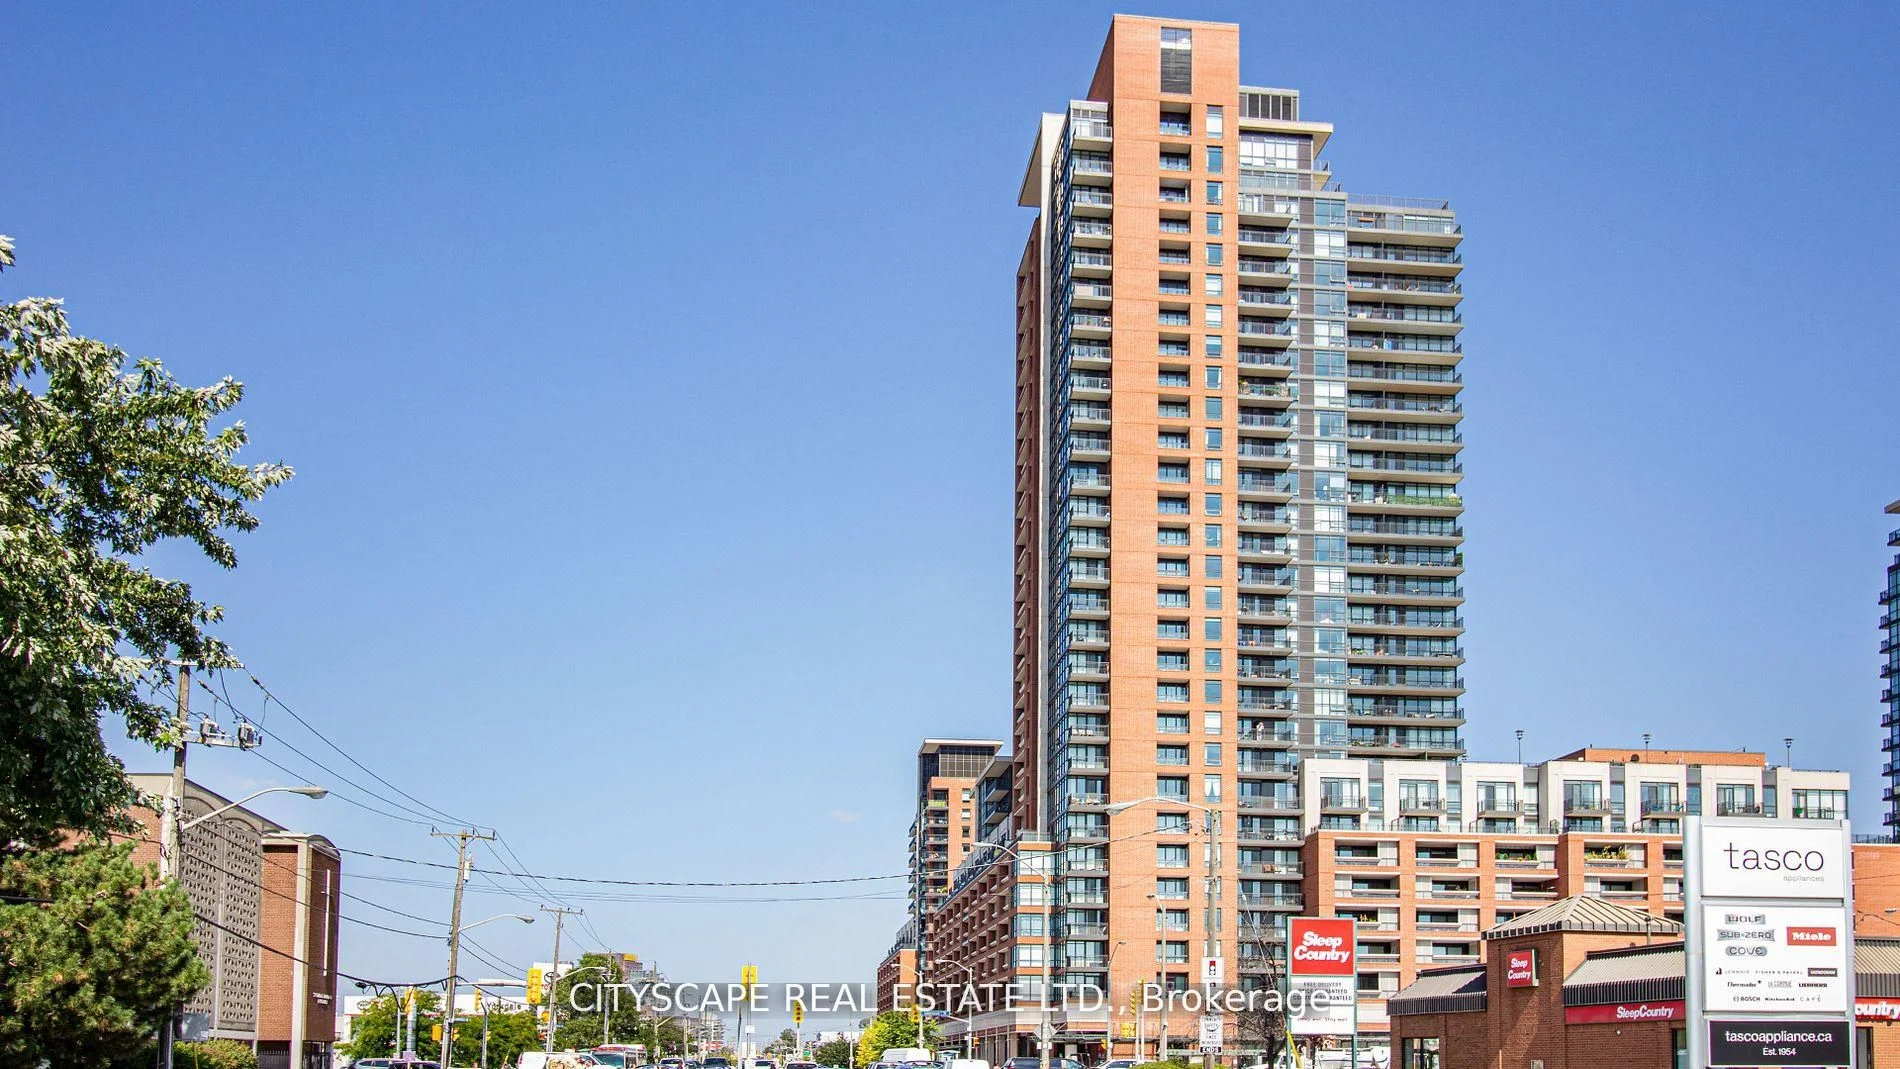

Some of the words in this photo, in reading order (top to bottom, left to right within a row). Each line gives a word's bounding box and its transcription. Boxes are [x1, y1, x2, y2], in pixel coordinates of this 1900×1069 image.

[1723, 842, 1824, 871] tasco
[1783, 875, 1825, 883] appliances
[1303, 931, 1343, 949] Sleep
[1792, 932, 1832, 941] Miele
[1293, 945, 1351, 964] Country
[1729, 947, 1764, 955] COVE
[1511, 957, 1528, 969] Sleep
[1508, 969, 1532, 980] Country
[1616, 1004, 1674, 1020] SleepCountry
[1725, 1031, 1833, 1044] tascoappliance.ca
[1762, 1047, 1777, 1056] Est.
[1778, 1047, 1797, 1056] 1954
